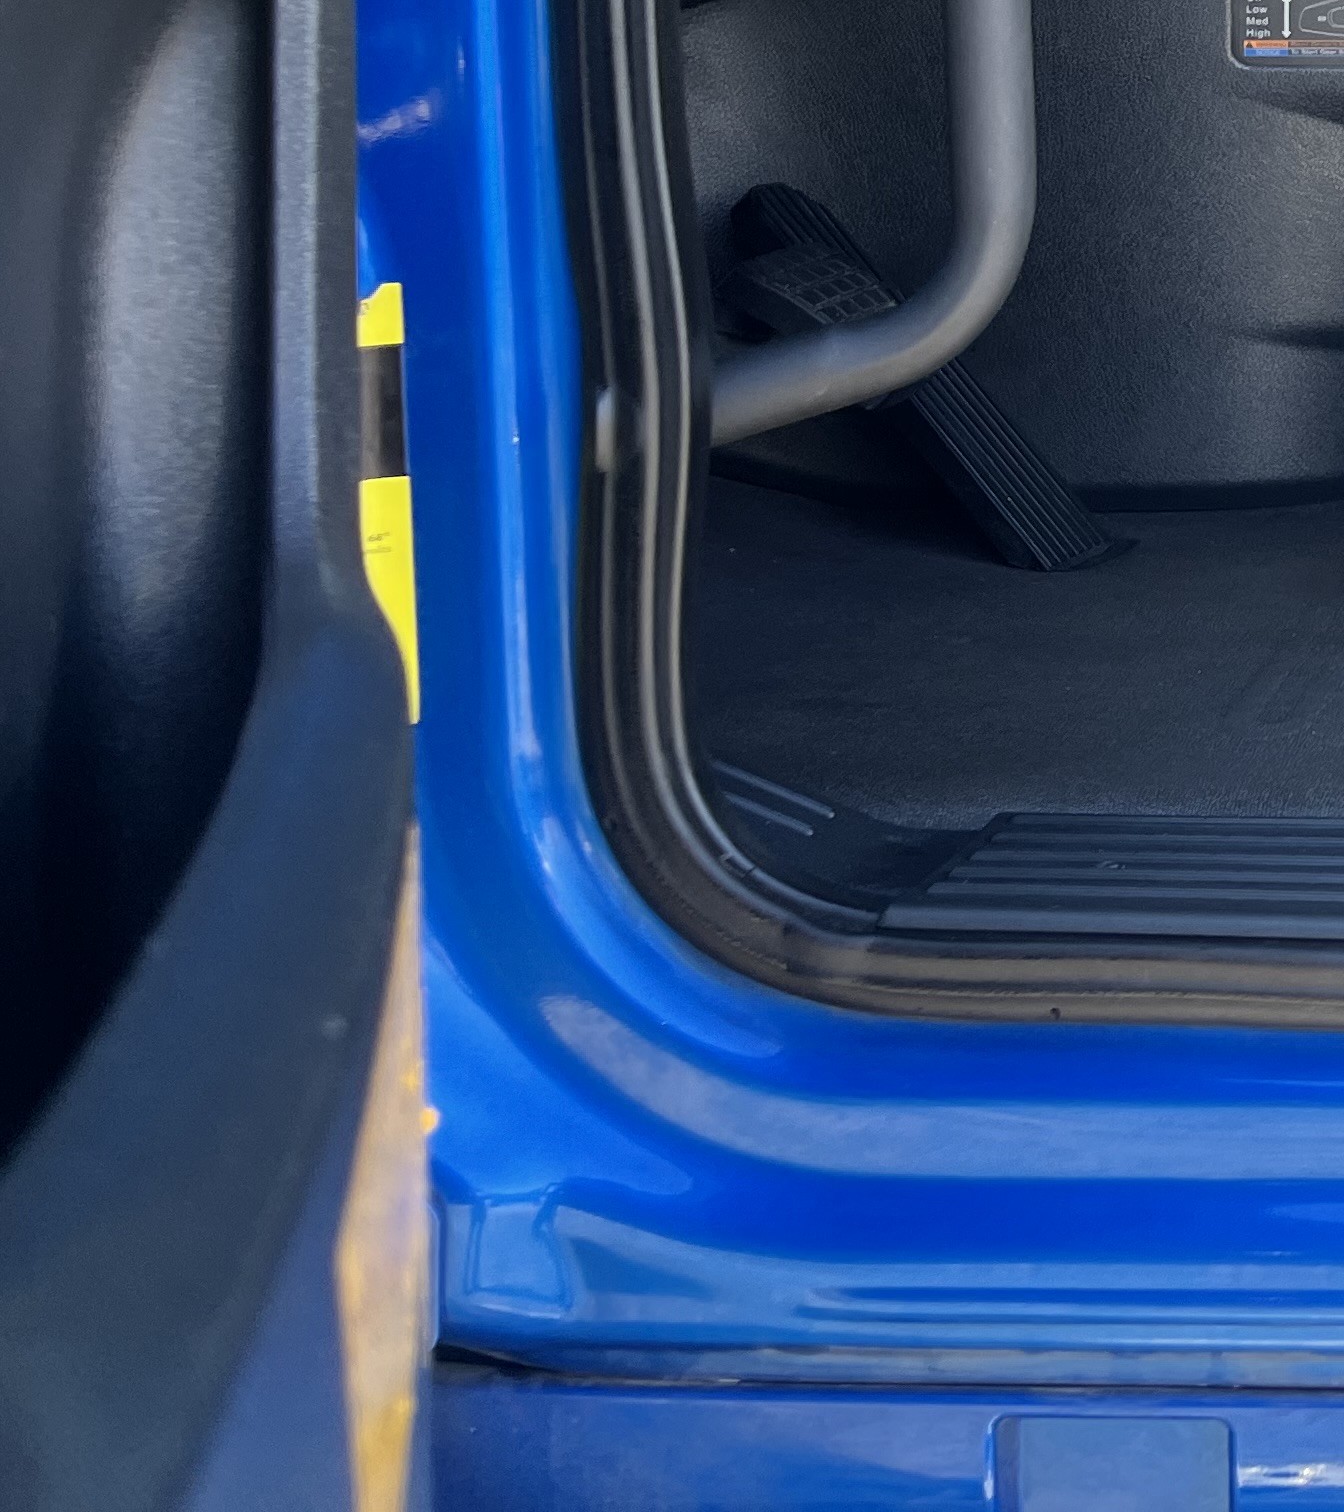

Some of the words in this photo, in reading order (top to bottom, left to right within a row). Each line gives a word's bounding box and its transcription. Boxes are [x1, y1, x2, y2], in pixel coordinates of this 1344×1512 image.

[1245, 5, 1268, 14] Low
[1245, 16, 1269, 26] Med
[1246, 29, 1271, 39] High
